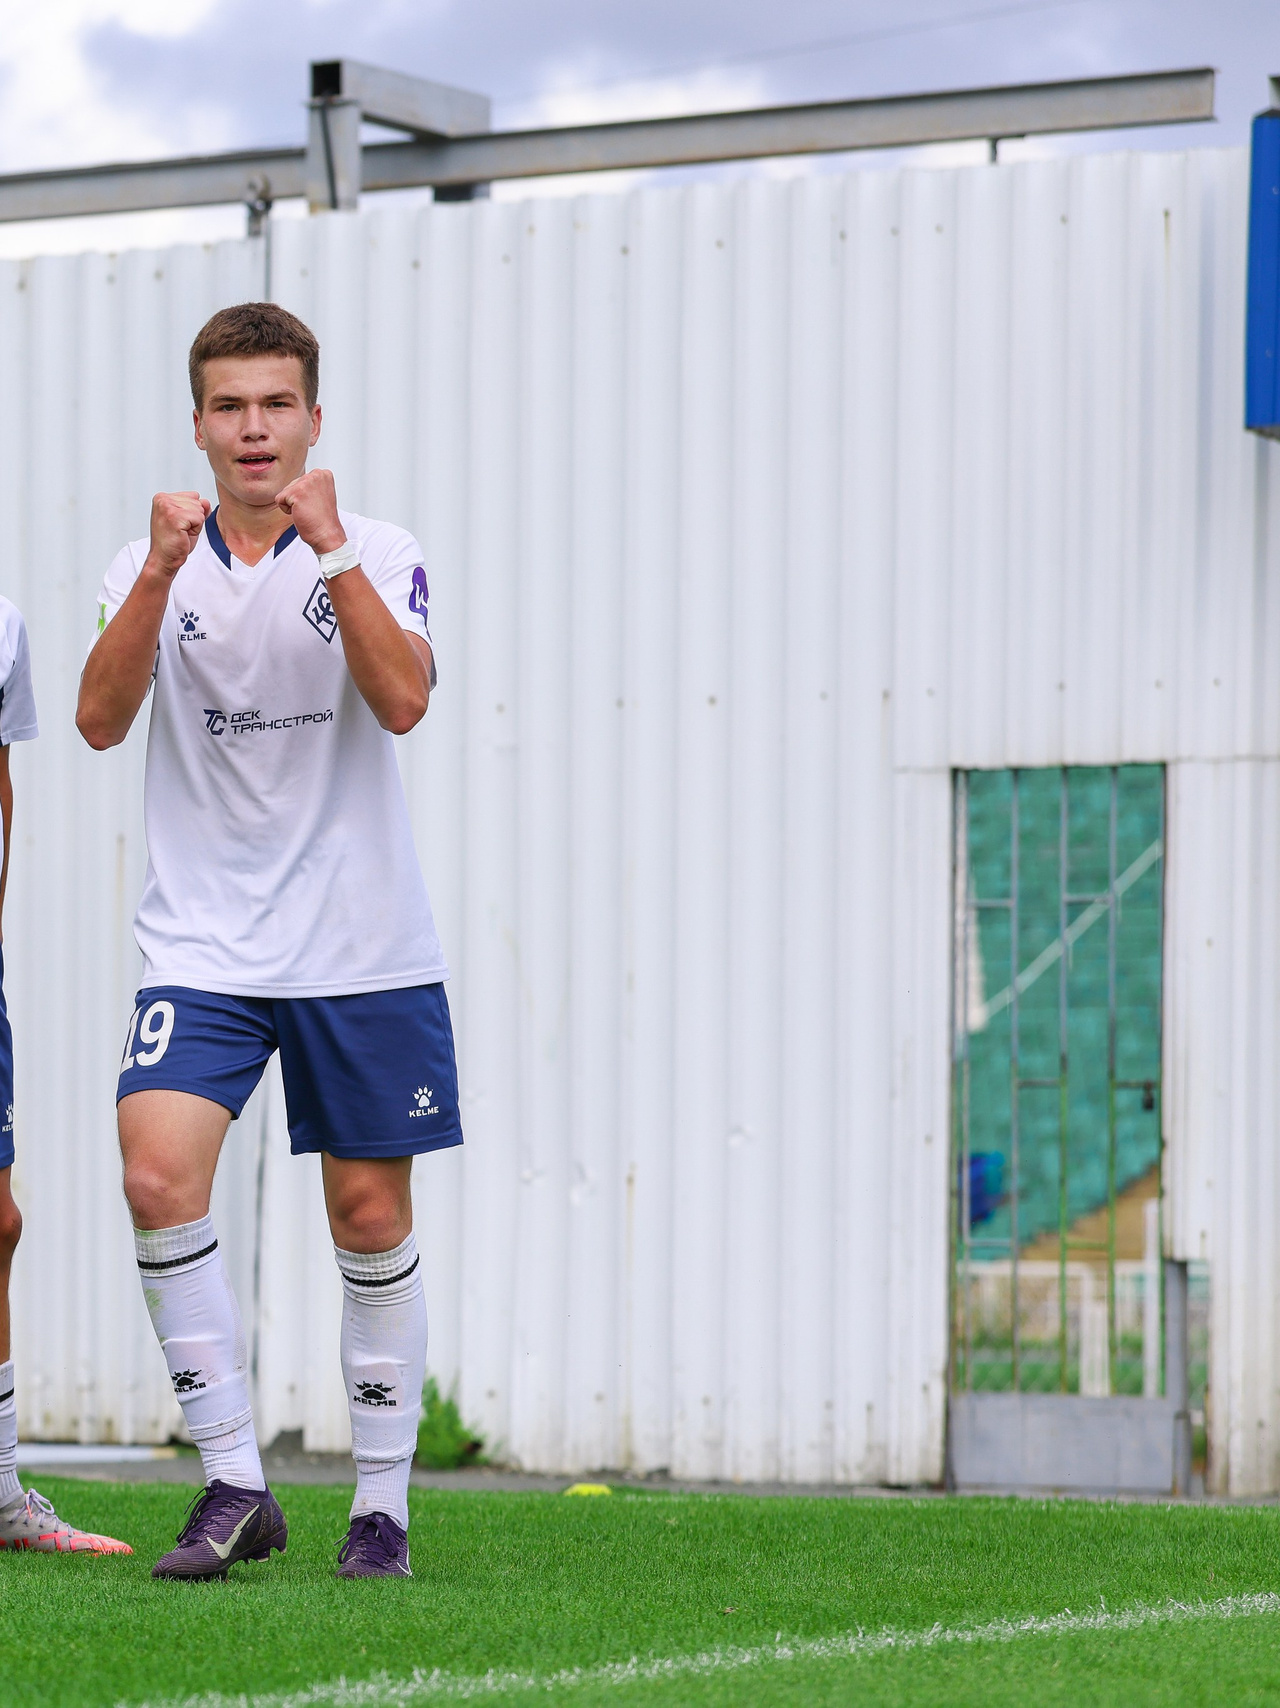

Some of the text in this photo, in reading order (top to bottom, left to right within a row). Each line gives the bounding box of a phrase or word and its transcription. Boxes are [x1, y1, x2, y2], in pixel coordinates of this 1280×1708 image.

[177, 632, 207, 641] ELME
[230, 709, 261, 723] ДСК
[230, 709, 334, 734] ТРАНССТРОЙ
[120, 1000, 175, 1075] 19
[408, 1106, 440, 1118] KELME
